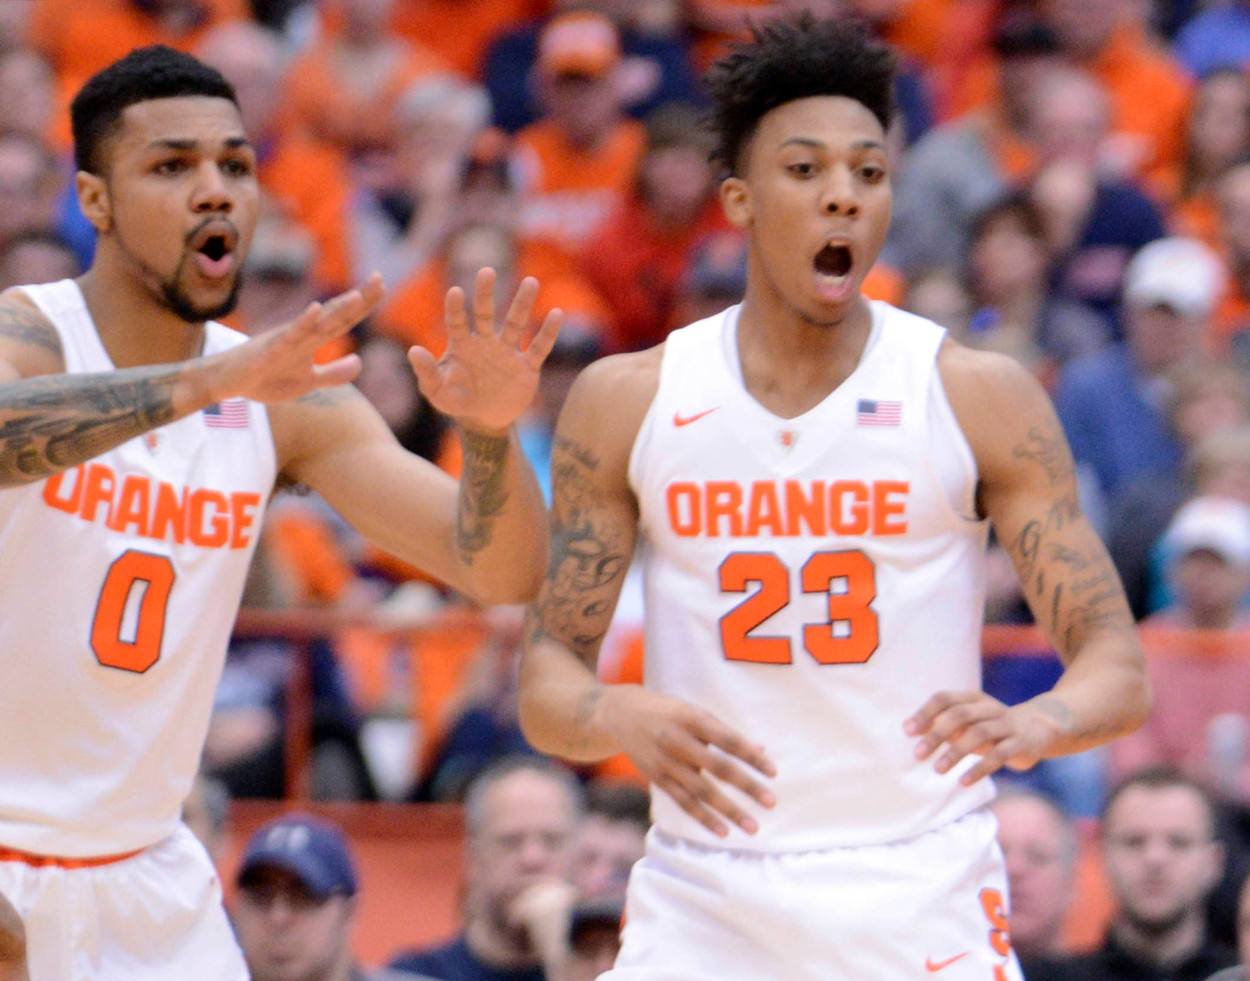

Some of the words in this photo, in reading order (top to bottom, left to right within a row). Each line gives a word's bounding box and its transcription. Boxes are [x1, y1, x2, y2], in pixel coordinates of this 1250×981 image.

[42, 463, 262, 550] ORANGE
[666, 480, 910, 537] ORANGE
[89, 548, 176, 674] 0
[718, 548, 880, 665] 23
